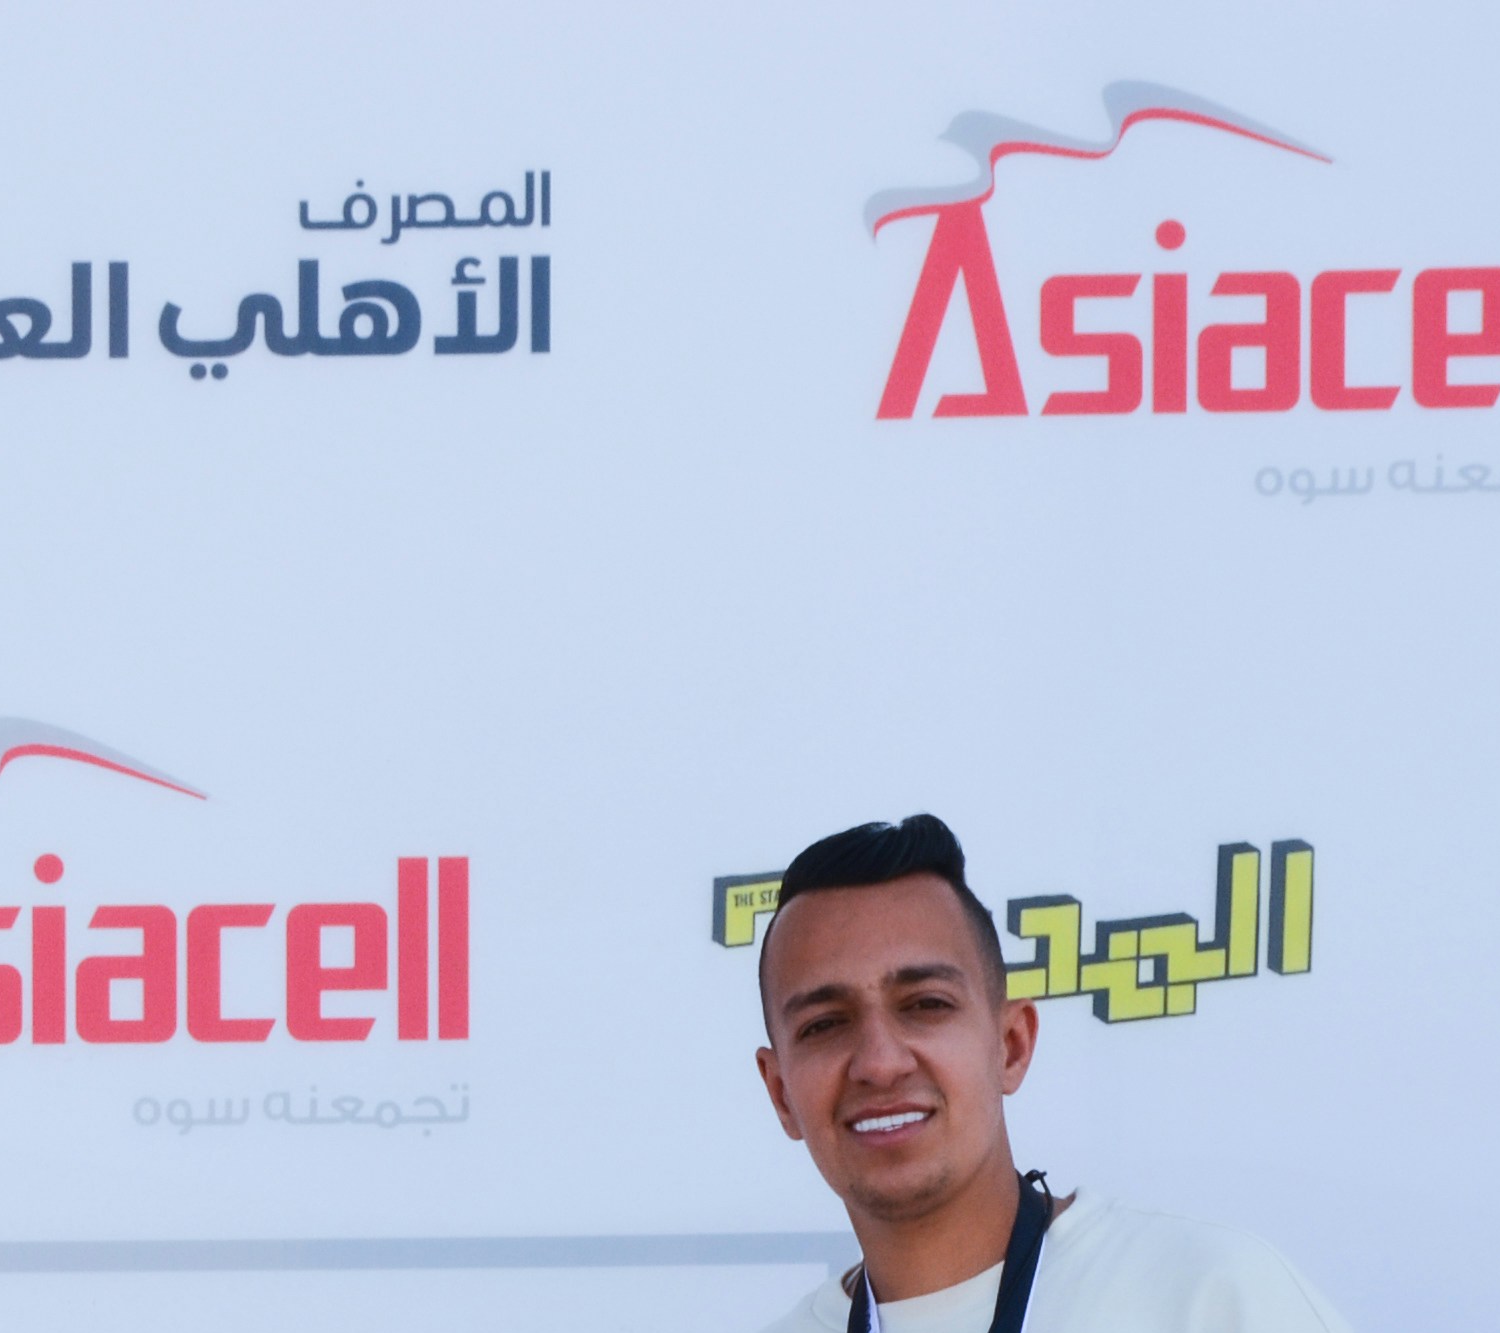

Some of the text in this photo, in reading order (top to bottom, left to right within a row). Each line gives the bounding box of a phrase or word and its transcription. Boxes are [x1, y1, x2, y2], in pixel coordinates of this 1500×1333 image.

[299, 170, 551, 246] المصرف
[158, 255, 551, 381] الأهلي
[1256, 466, 1373, 506] سوه
[134, 1098, 248, 1134] سوه
